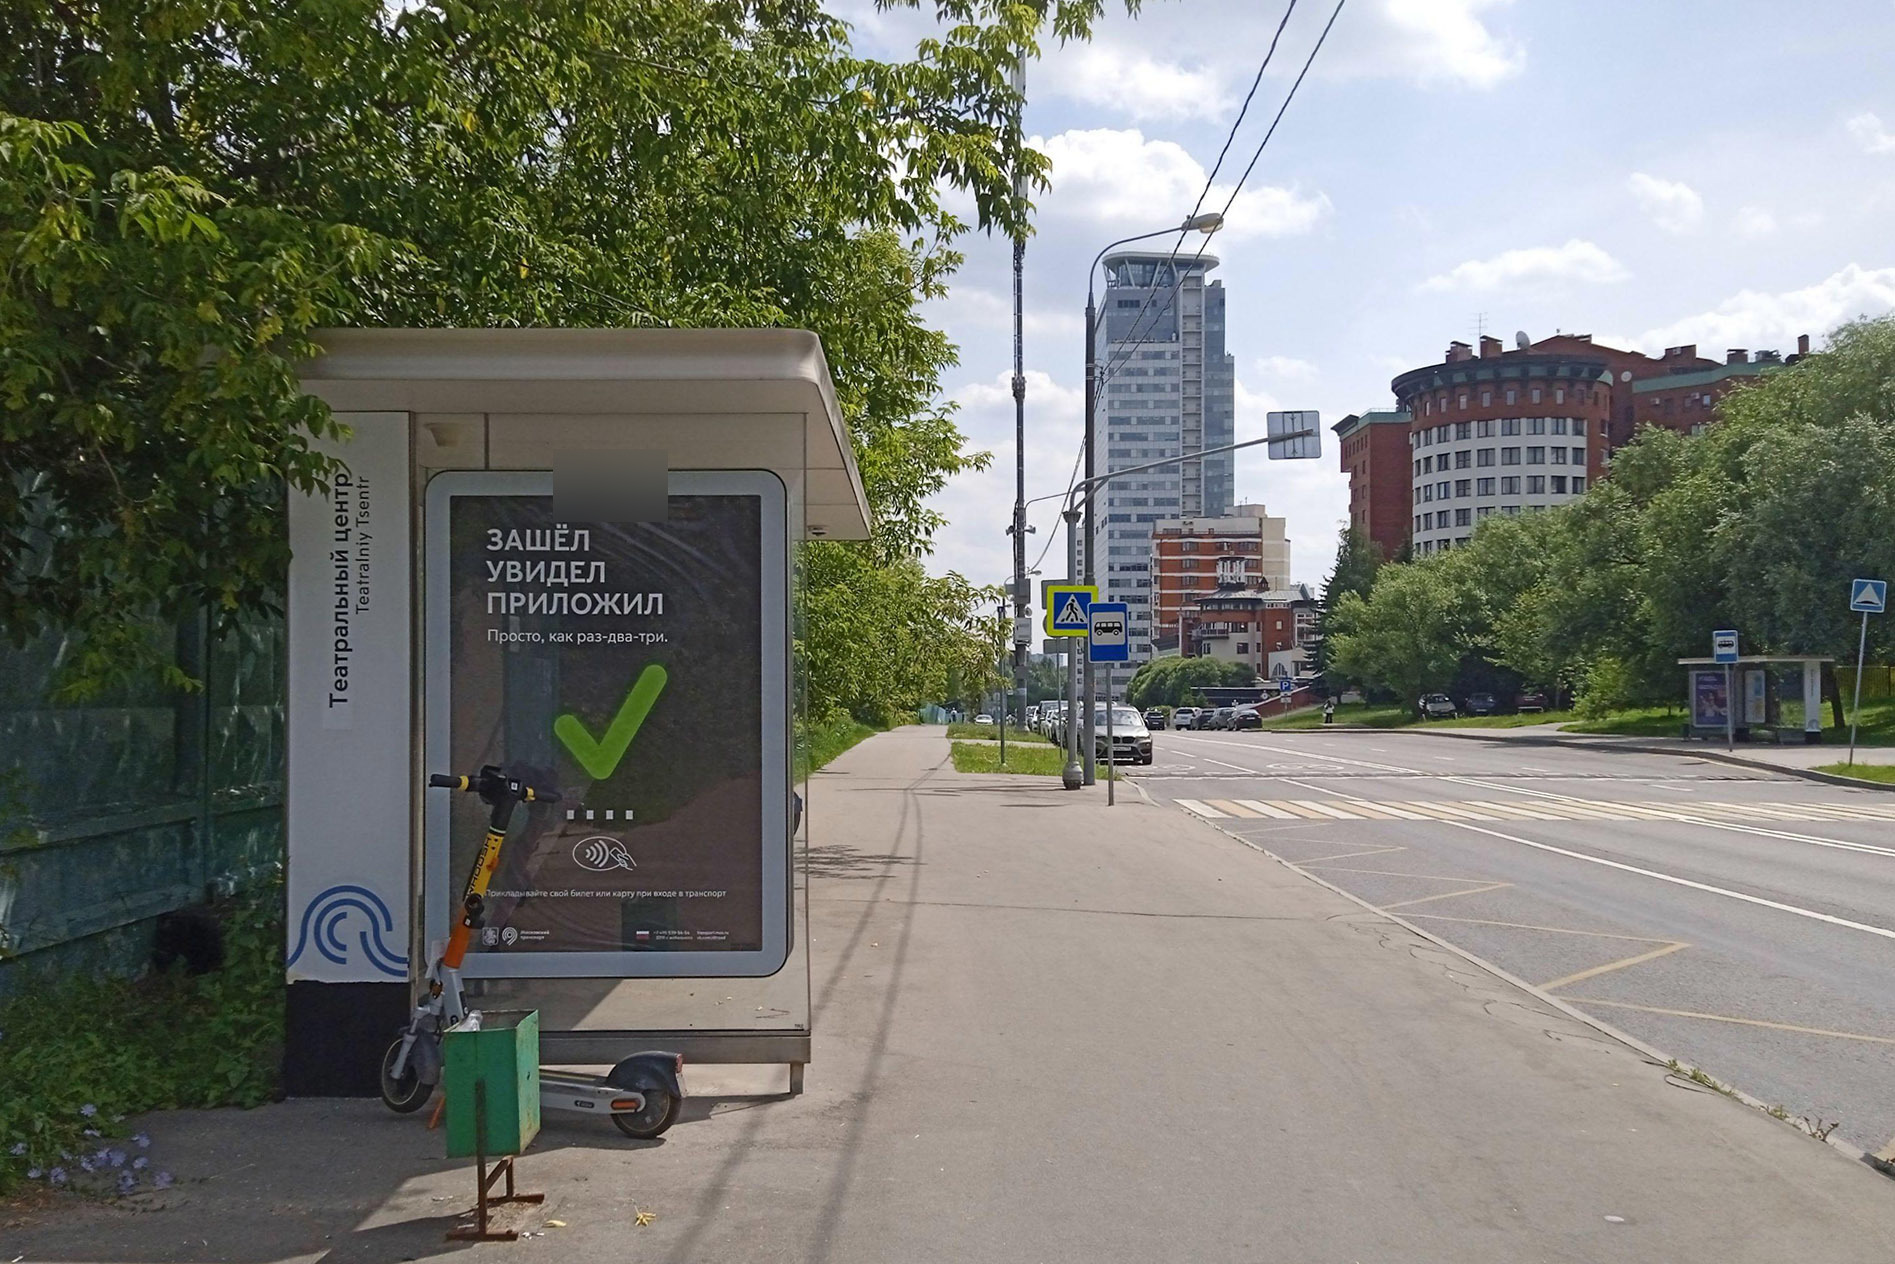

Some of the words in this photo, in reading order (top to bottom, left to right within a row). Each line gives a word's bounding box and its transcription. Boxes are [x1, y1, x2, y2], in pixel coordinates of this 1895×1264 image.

[334, 473, 354, 542] центр
[355, 475, 371, 528] Tsentr
[486, 523, 591, 552] ЗАШЁЛ
[355, 533, 373, 615] Teatralniy
[485, 560, 606, 587] УВИДЕЛ
[487, 592, 664, 615] ПРИЛОЖИЛ
[329, 549, 354, 708] Театральный
[487, 629, 545, 645] Просто,
[549, 631, 574, 643] как
[577, 631, 668, 645] раз-два-три.
[549, 889, 569, 897] свой
[570, 888, 594, 897] билет
[612, 890, 635, 899] карту
[636, 890, 652, 898] при
[653, 890, 677, 898] входе
[685, 890, 727, 898] транспорт
